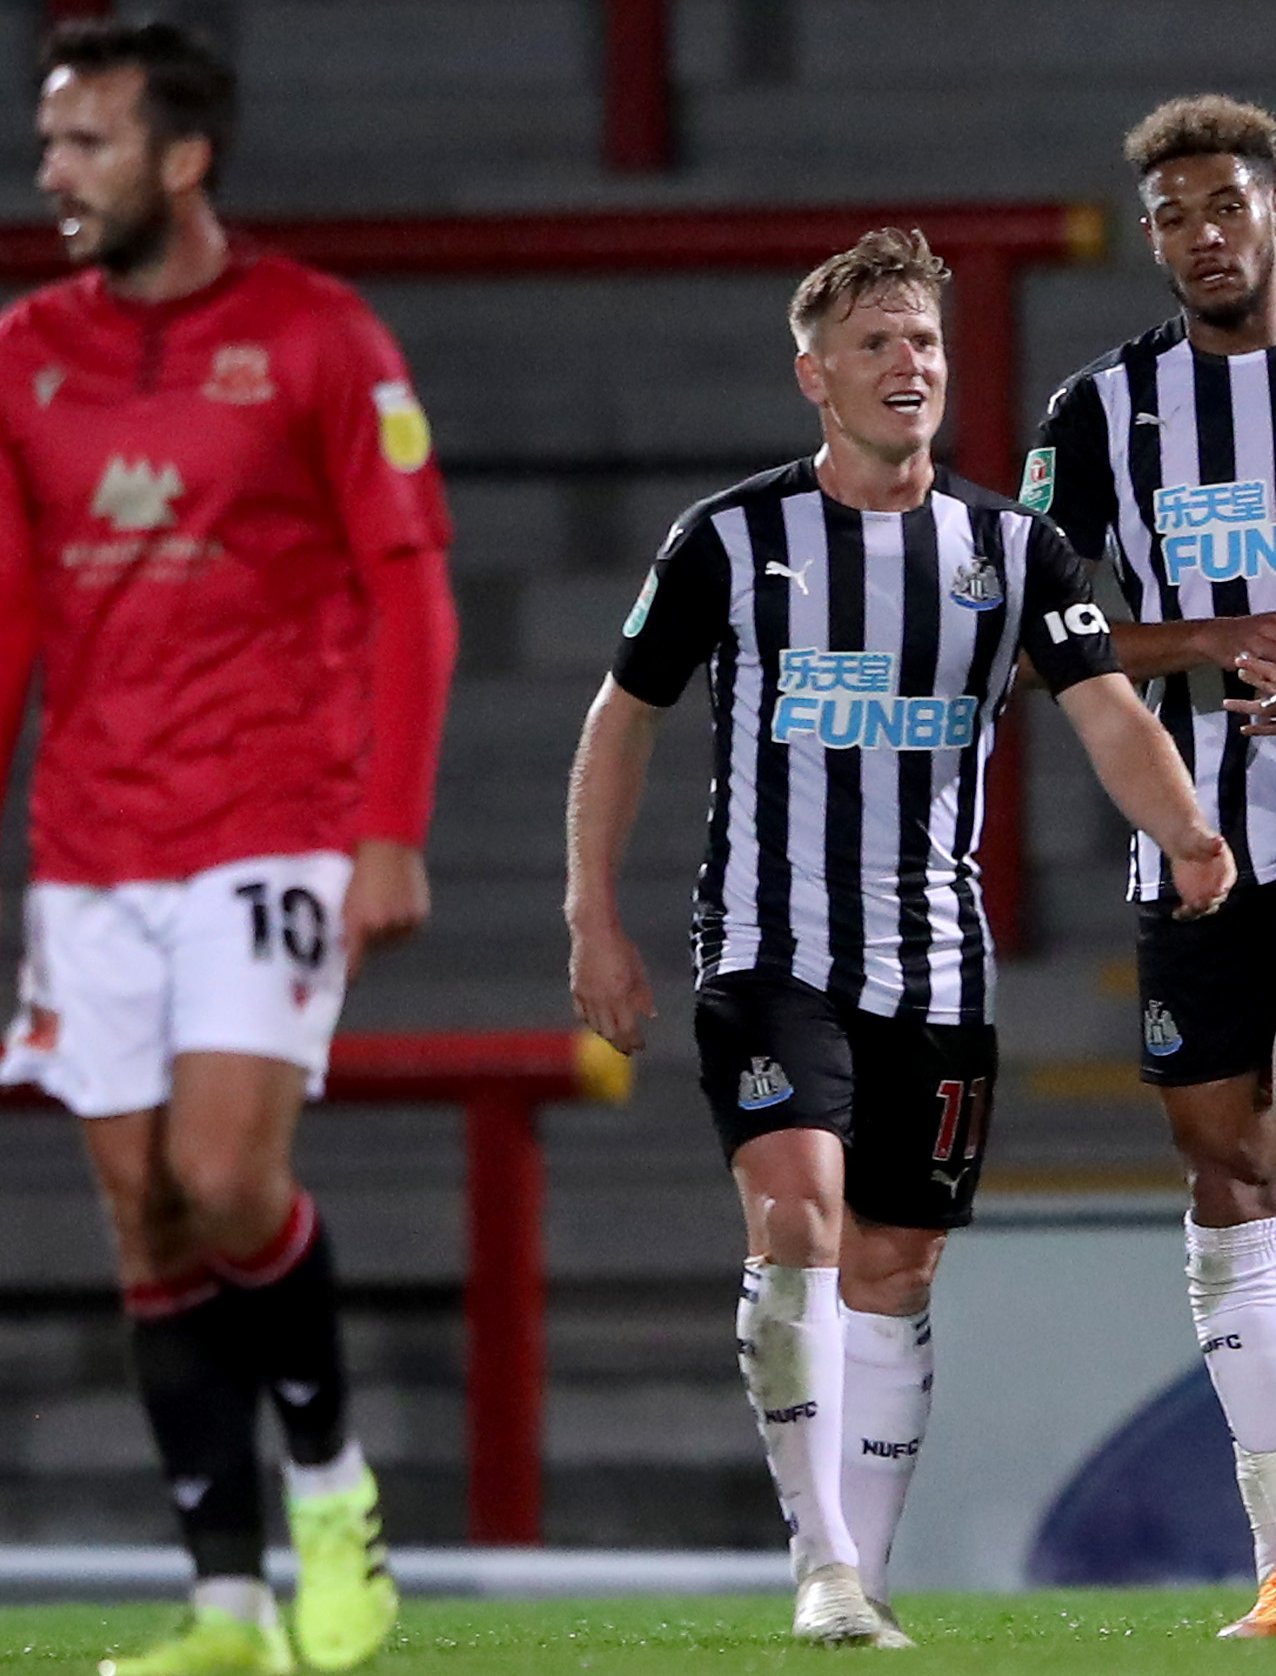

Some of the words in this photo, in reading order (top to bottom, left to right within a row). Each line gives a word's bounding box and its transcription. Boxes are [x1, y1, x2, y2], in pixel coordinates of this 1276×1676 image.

[1155, 481, 1267, 530] 乐天堂
[1043, 603, 1111, 645] IC
[780, 649, 893, 693] 乐天堂
[771, 696, 988, 750] FUN88
[233, 882, 326, 969] 10
[764, 1400, 818, 1425] NUFC
[861, 1436, 920, 1460] NUFC
